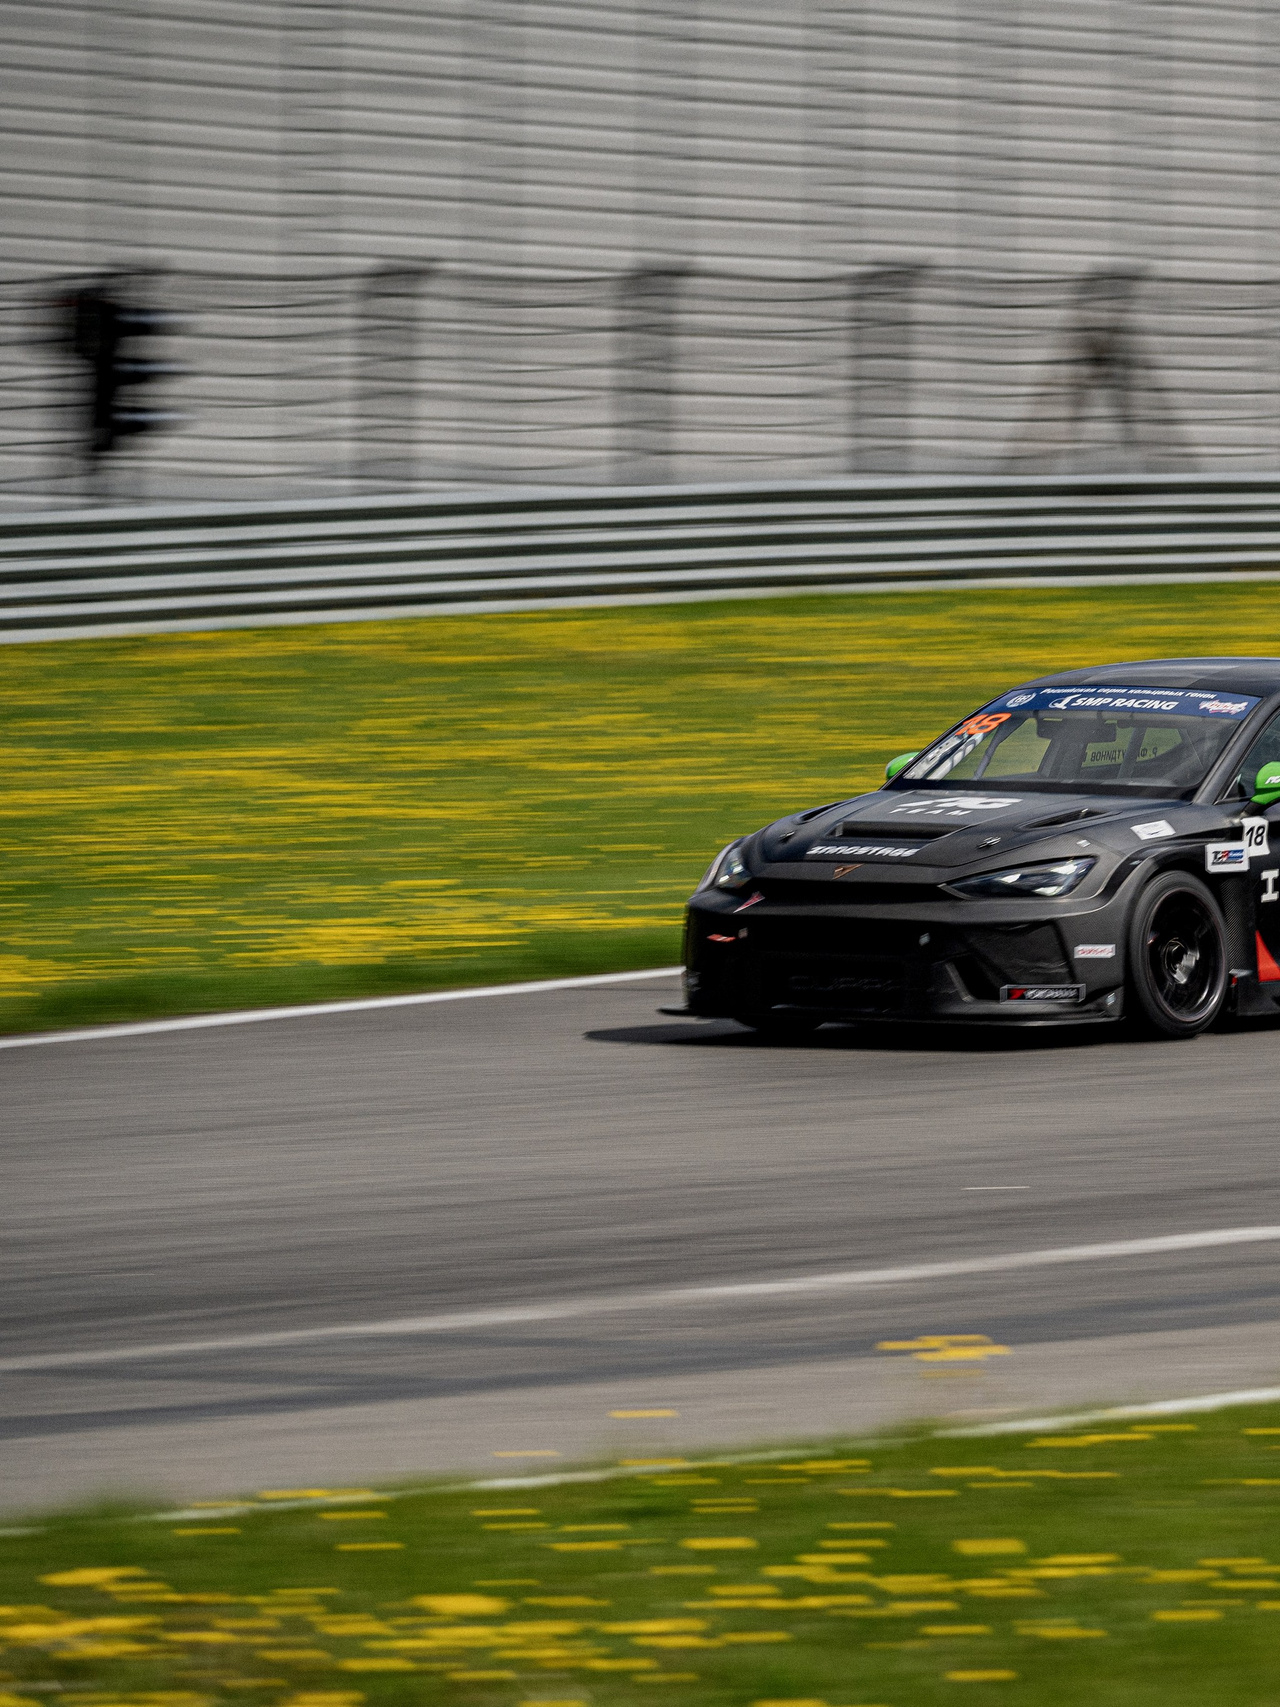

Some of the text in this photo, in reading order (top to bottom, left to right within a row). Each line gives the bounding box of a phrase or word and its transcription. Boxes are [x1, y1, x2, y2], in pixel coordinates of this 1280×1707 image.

[1070, 697, 1179, 710] SMP RACING
[955, 712, 1013, 736] 18
[1245, 825, 1266, 848] 18
[806, 845, 921, 857] INNOSTAGE
